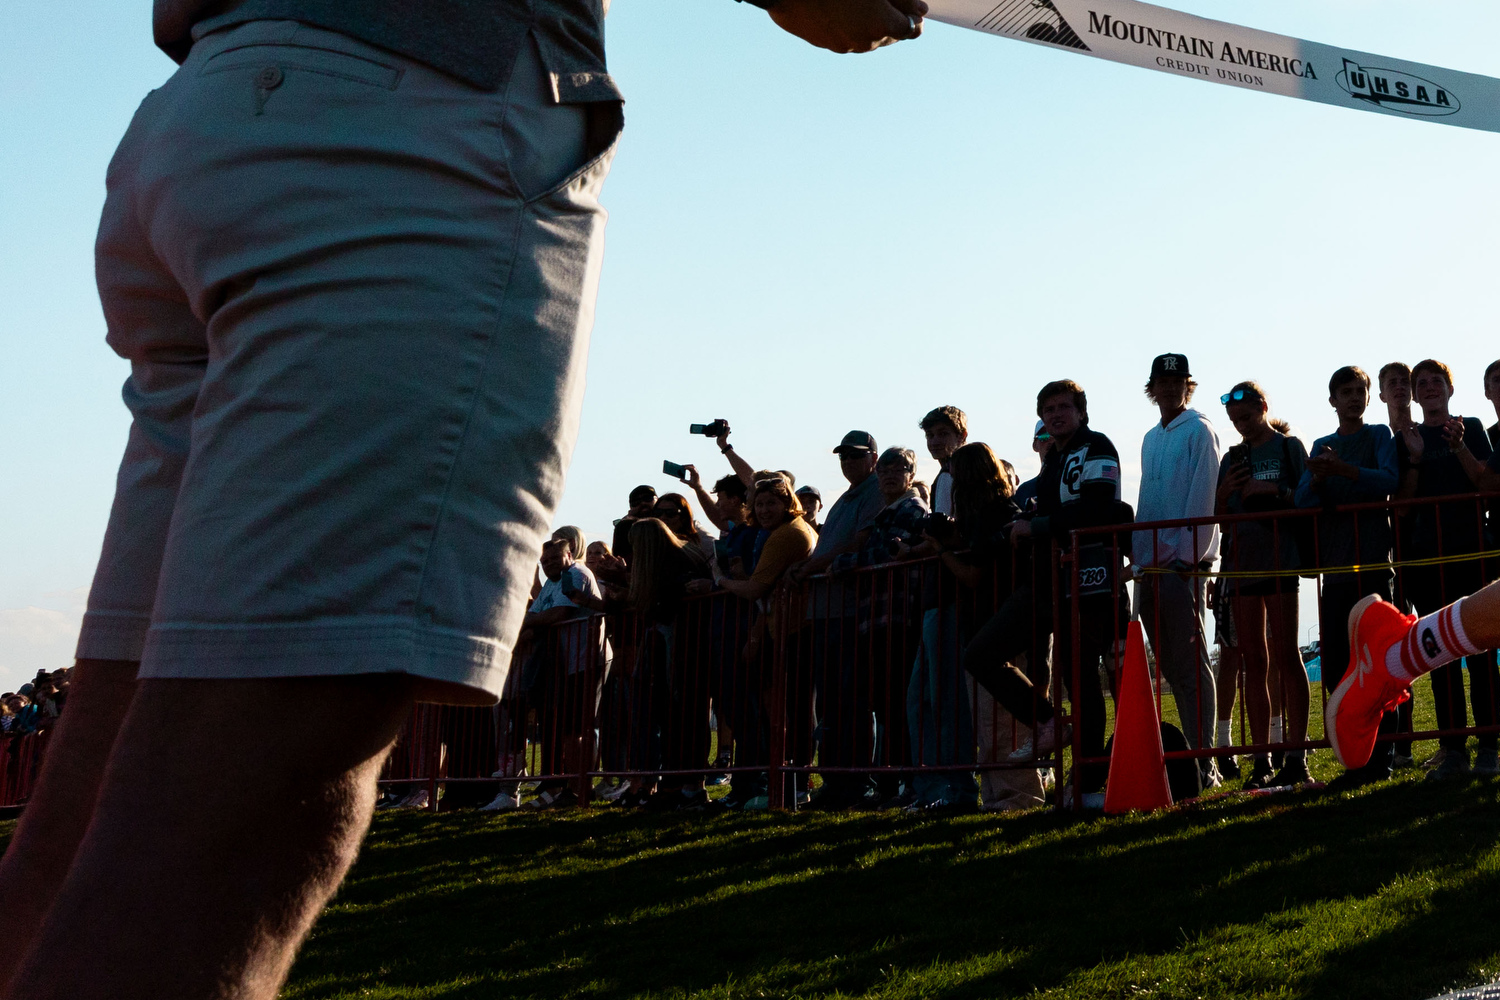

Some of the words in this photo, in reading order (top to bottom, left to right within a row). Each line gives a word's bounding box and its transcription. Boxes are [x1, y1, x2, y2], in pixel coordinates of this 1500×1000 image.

[1155, 55, 1211, 77] CREDIT
[1215, 67, 1264, 87] UNION
[1350, 70, 1451, 107] UHSAA
